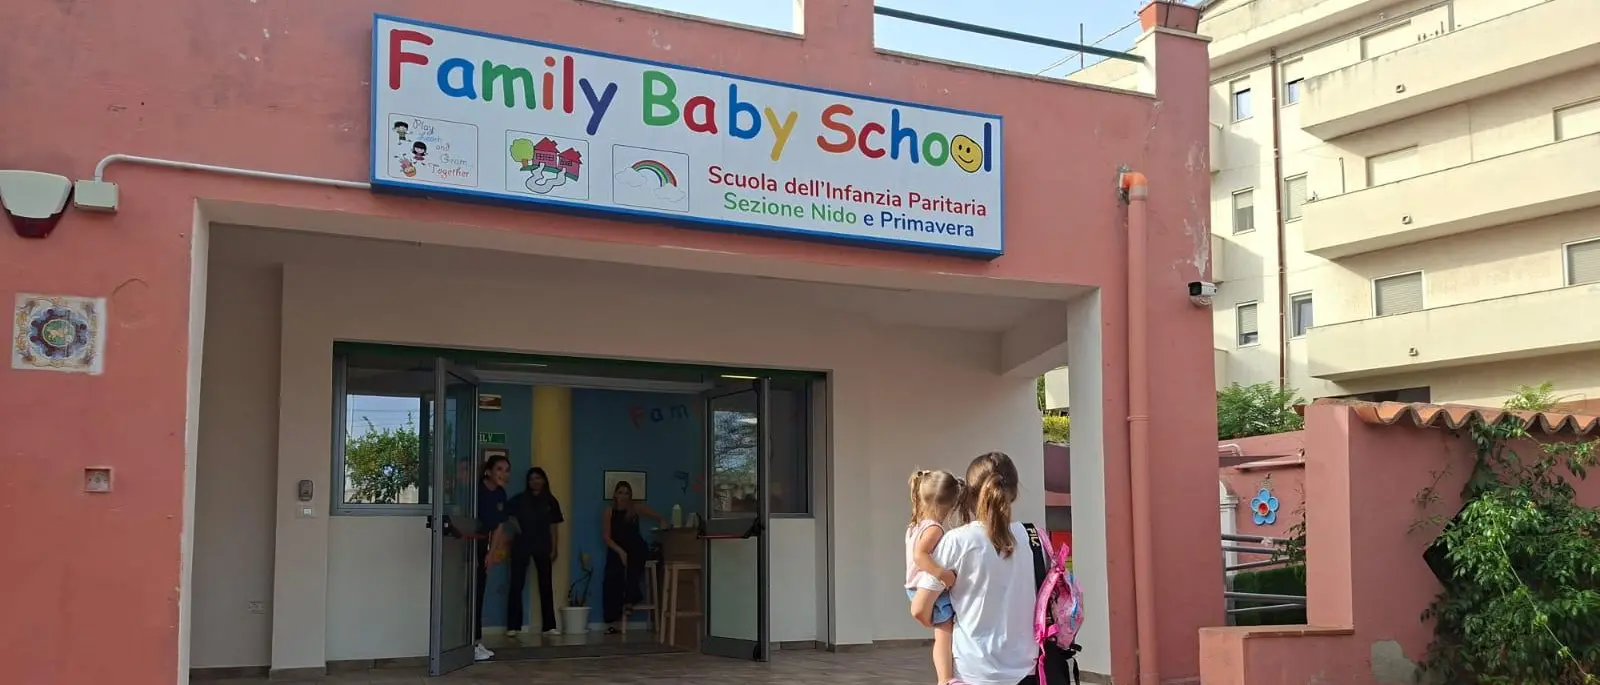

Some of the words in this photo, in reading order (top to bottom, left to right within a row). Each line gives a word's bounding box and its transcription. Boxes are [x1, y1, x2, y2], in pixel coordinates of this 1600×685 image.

[388, 28, 618, 136] Family
[642, 70, 798, 161] Baby
[816, 103, 992, 173] School
[707, 165, 777, 192] Scuola
[784, 177, 902, 208] dell'Infanzia
[908, 192, 987, 217] Paritaria
[723, 192, 805, 219] Sezione
[811, 203, 857, 224] Nido
[863, 213, 874, 226] e
[880, 211, 974, 238] Primavera
